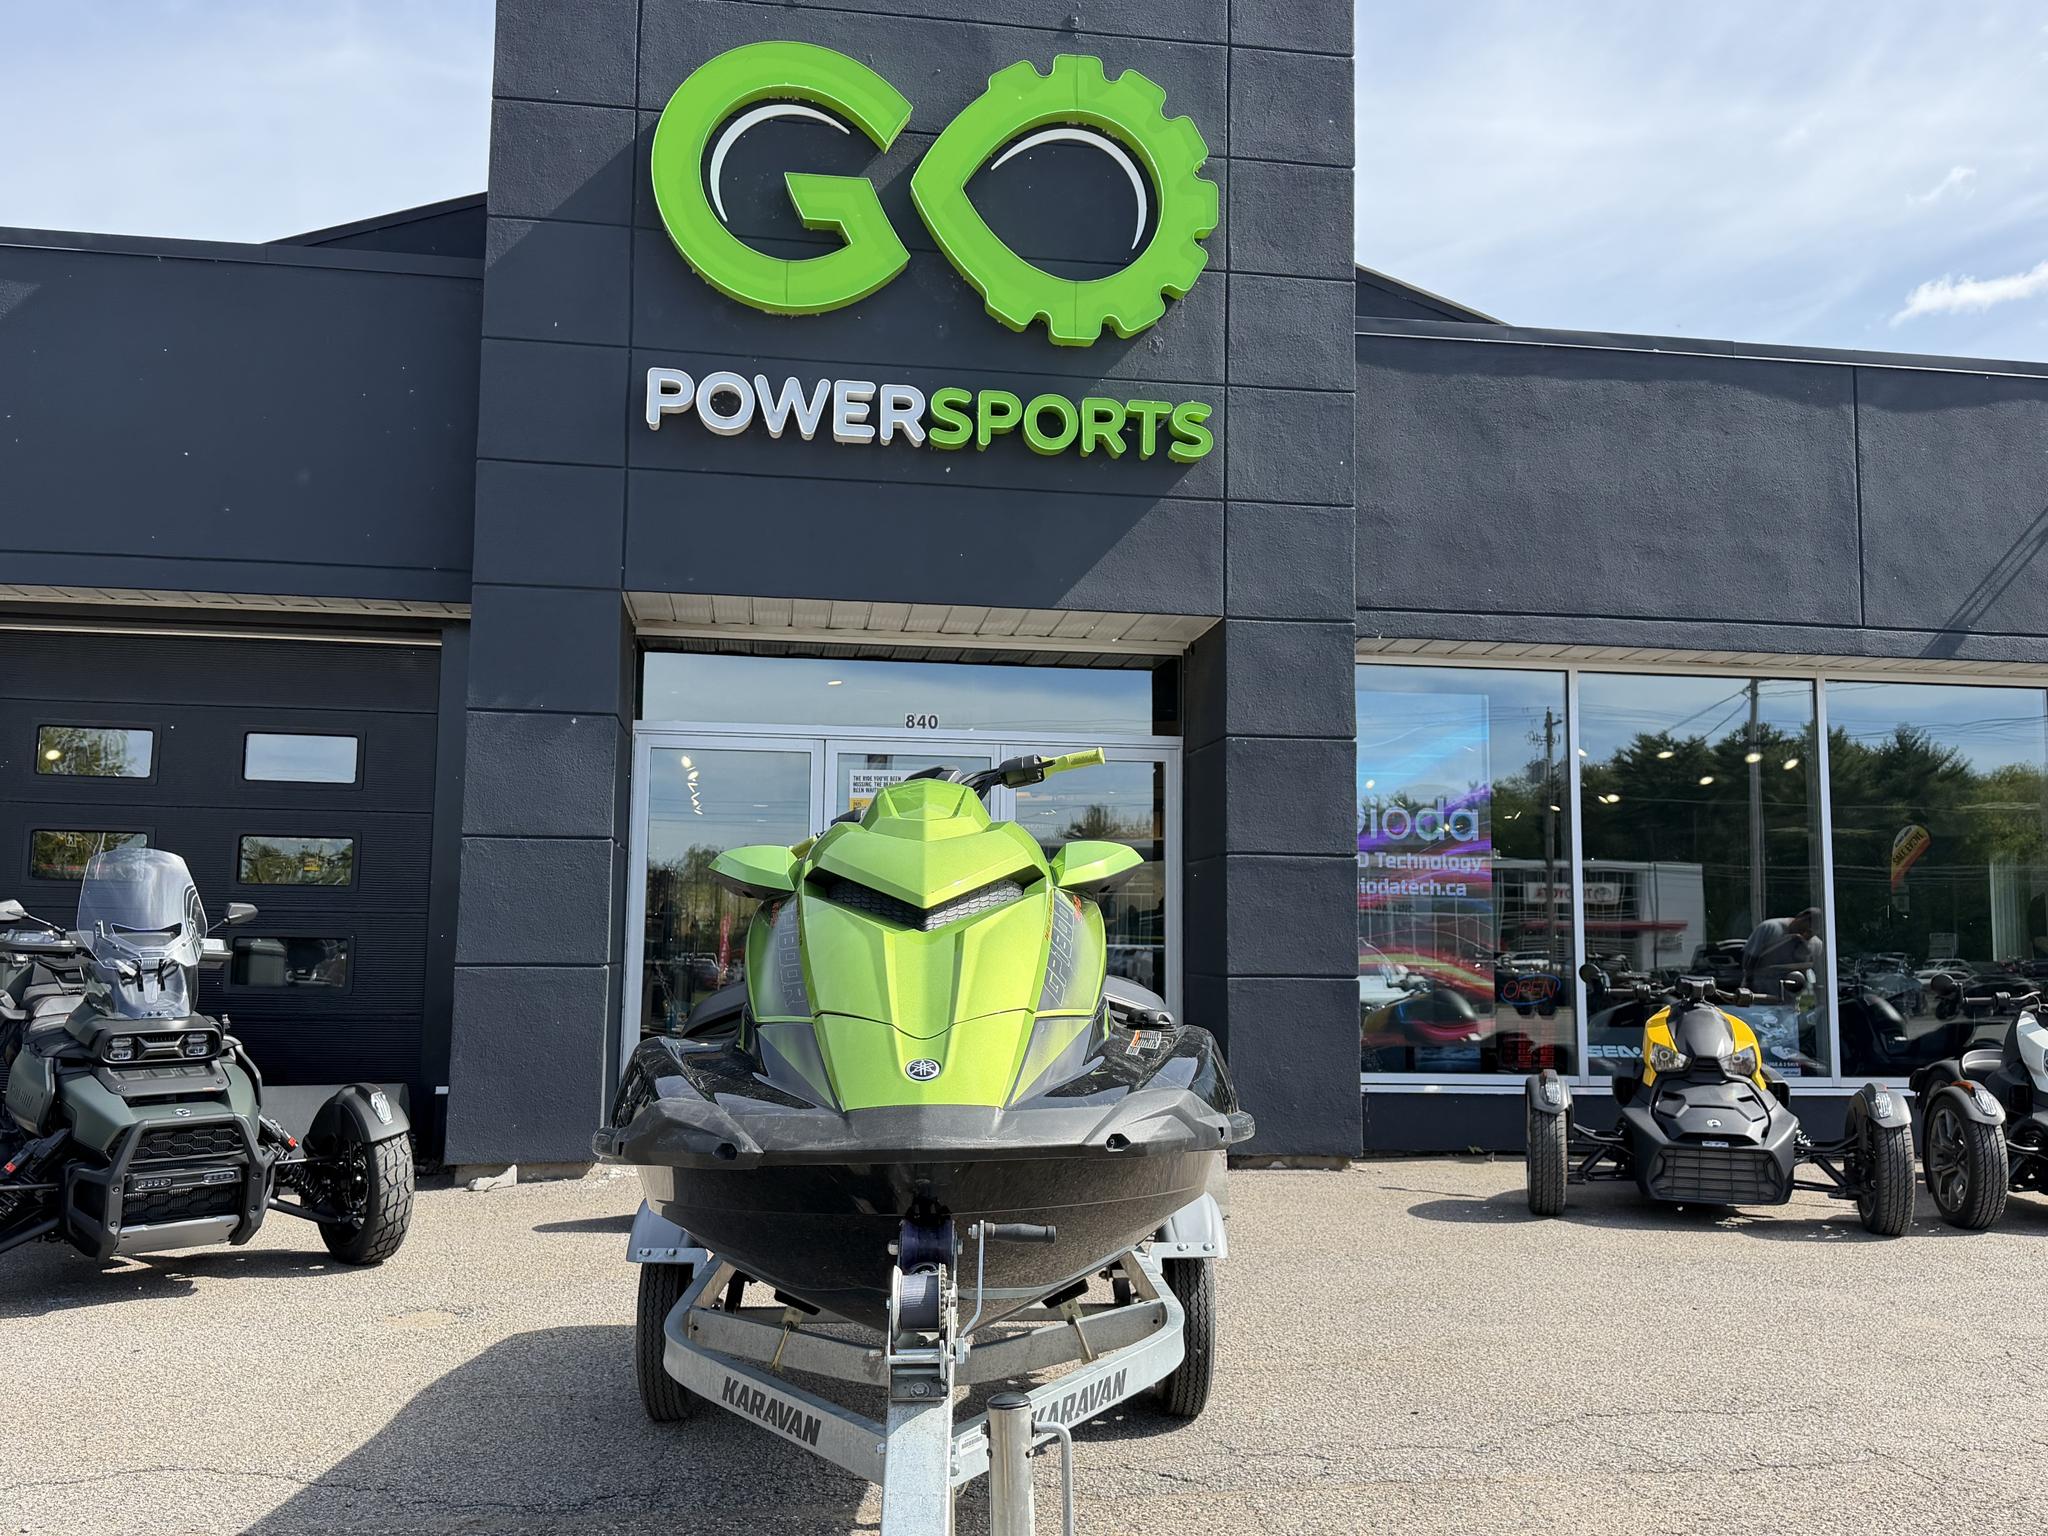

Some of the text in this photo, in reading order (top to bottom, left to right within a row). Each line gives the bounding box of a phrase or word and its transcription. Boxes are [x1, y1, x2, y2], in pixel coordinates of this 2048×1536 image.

[651, 40, 1219, 347] GO
[645, 366, 1214, 464] POWERSPORTS
[906, 714, 939, 729] 840
[1375, 852, 1482, 875] Technology
[1503, 979, 1556, 999] OPEN
[722, 1375, 822, 1447] KARAVAN
